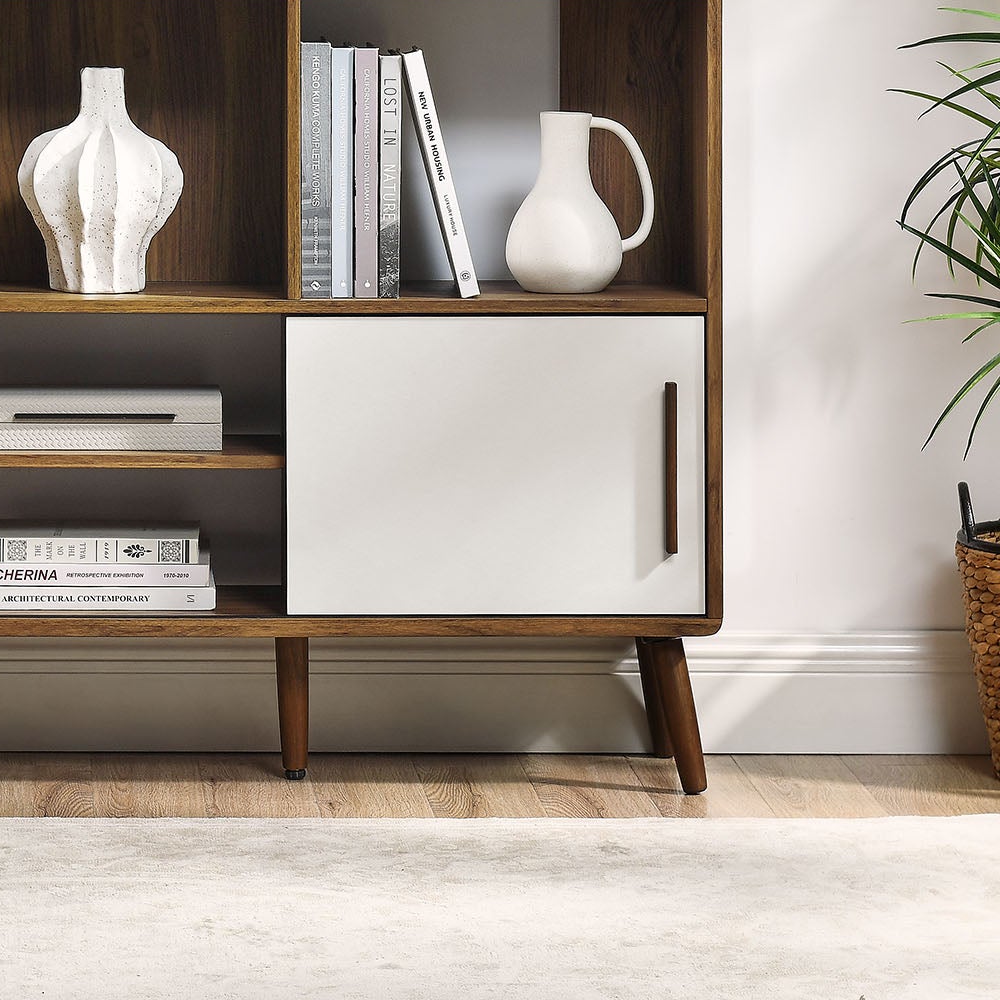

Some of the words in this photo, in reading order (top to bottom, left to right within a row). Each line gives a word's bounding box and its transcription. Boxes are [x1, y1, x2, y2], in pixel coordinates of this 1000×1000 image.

[312, 56, 320, 89] KENGO
[312, 91, 320, 117] KUMA
[384, 78, 397, 116] LOST
[312, 120, 320, 170] COMPLETE
[384, 129, 397, 145] IN
[418, 91, 428, 110] NEW
[424, 113, 436, 142] URBAN
[431, 145, 445, 182] HOUSING
[312, 172, 320, 207] WORKS
[382, 164, 395, 221] NATURE
[449, 217, 458, 236] HOUSE
[57, 546, 64, 555] ON
[1, 595, 75, 603] ARCHITECTURAL
